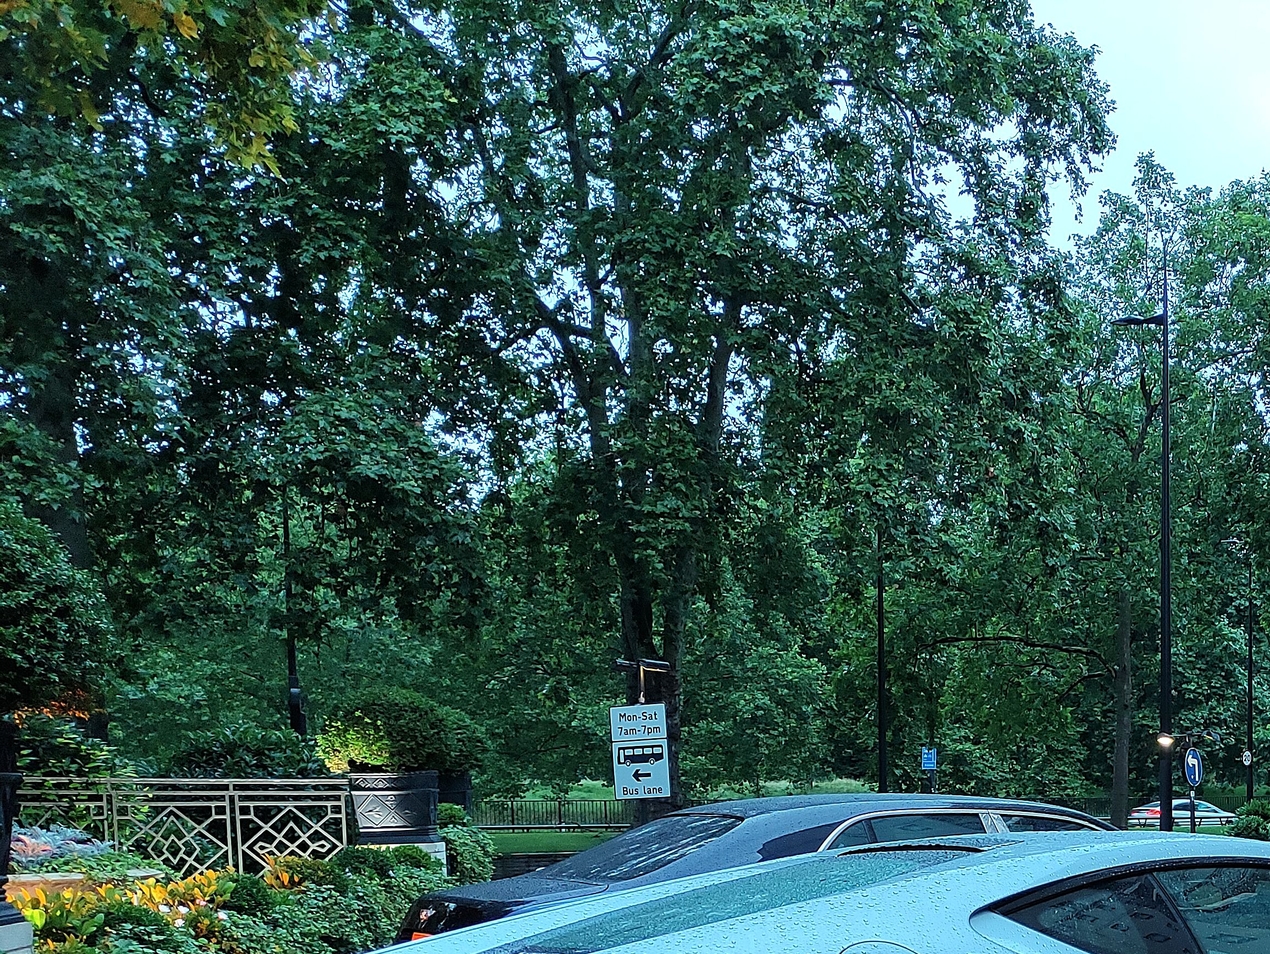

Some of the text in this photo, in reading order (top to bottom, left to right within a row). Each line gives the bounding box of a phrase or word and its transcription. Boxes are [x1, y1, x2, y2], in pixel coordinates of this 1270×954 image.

[619, 711, 658, 722] Mon-Sat
[618, 725, 661, 736] 7am-7pm
[622, 785, 663, 796] Bus lane
